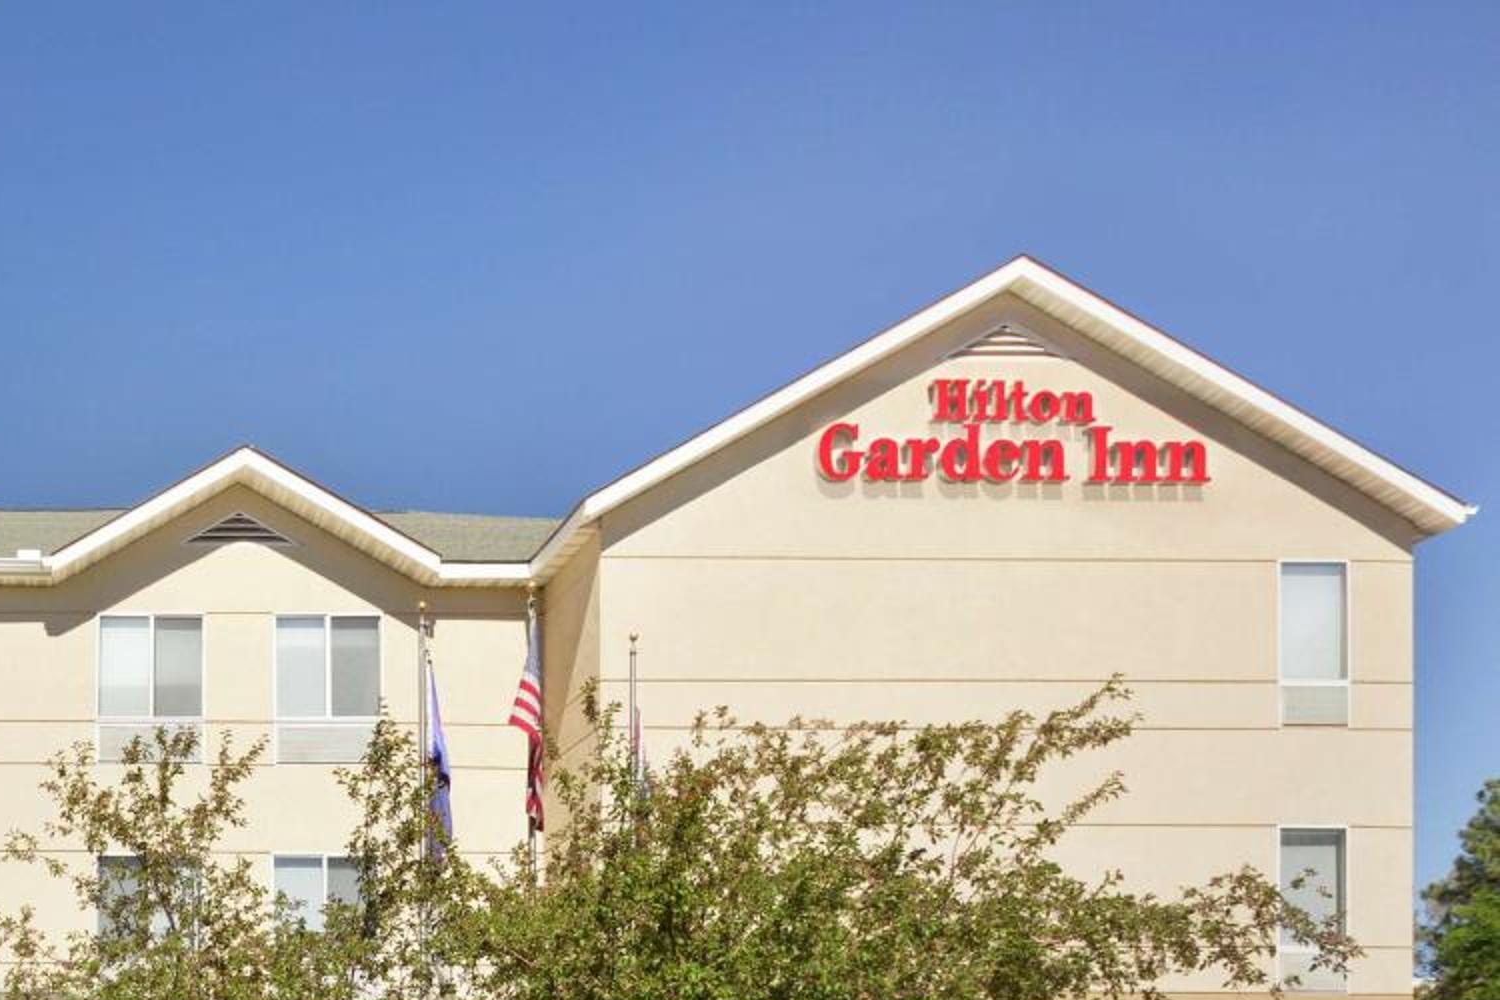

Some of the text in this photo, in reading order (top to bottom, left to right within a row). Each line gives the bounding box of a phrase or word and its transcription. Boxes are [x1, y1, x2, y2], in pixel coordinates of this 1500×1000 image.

[933, 378, 1095, 423] Hilton
[818, 423, 1210, 484] Garden Inn
